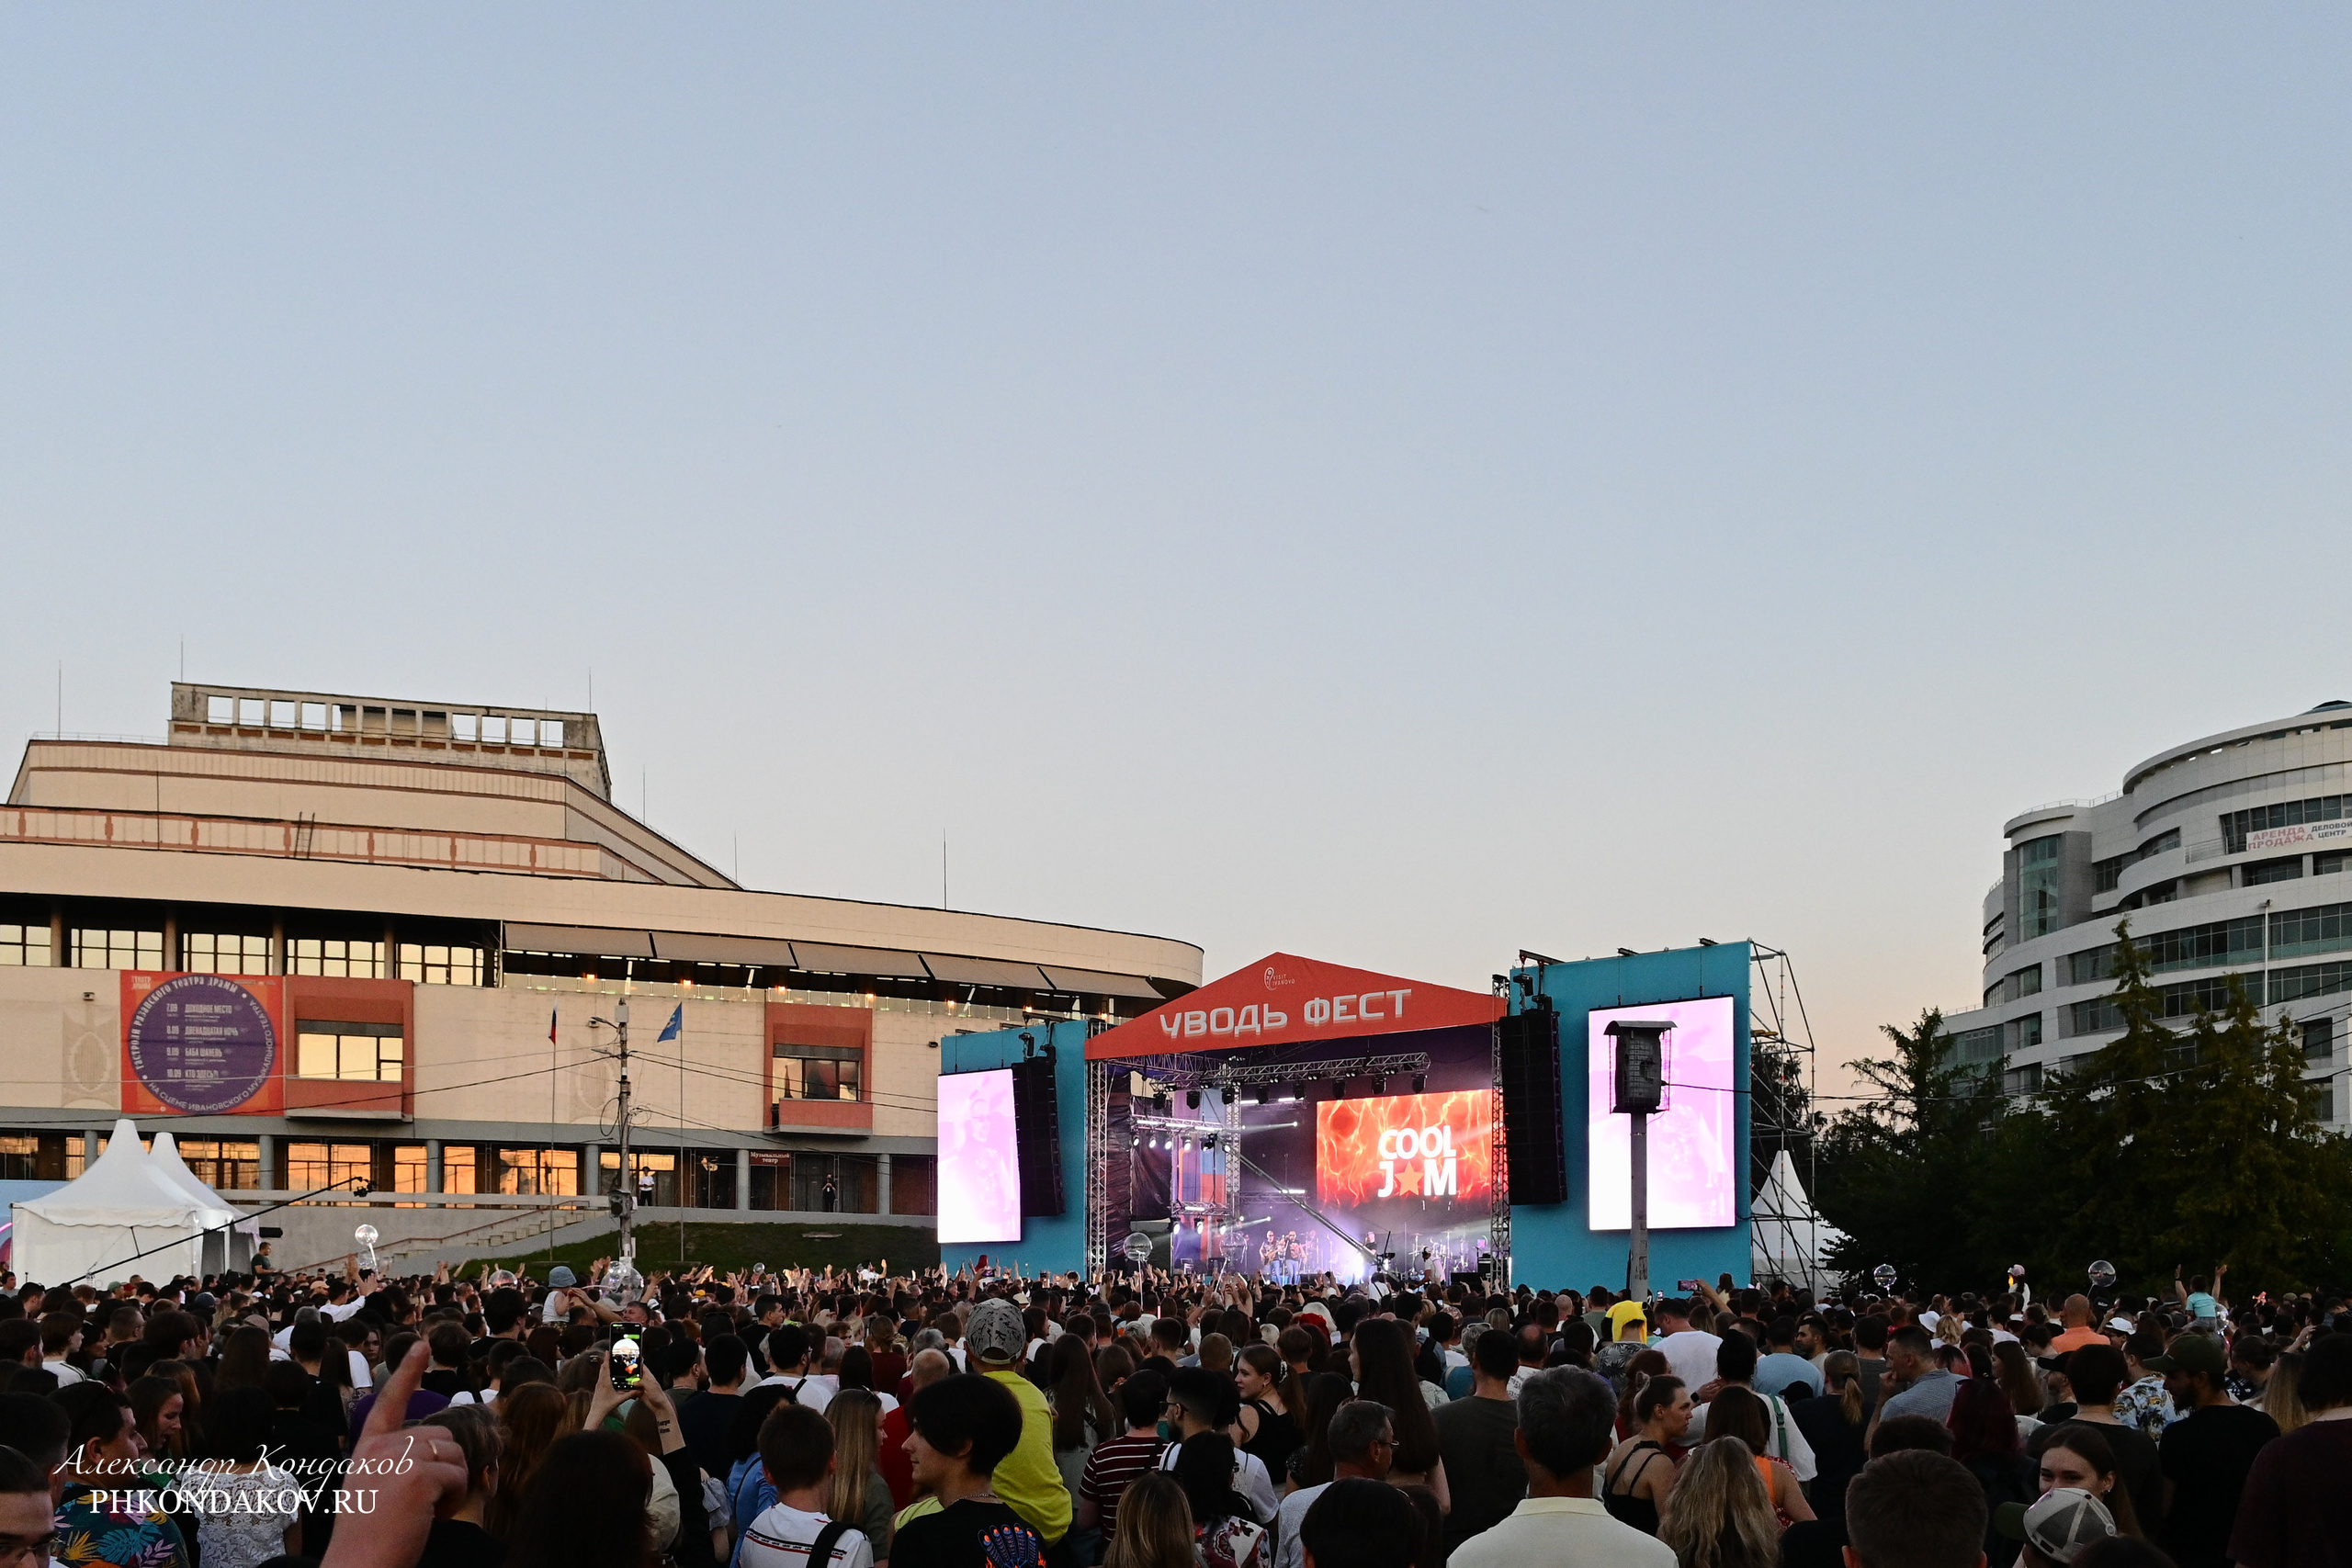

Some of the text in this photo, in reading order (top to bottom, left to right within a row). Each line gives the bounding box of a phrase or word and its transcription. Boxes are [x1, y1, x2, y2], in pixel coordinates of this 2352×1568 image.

[2253, 826, 2305, 841] АРЕНДА
[2312, 821, 2352, 832] ДЕЛОВОЙ
[2318, 829, 2346, 839] ЦЕНТР
[2247, 833, 2314, 850] ПРОДАЖА
[249, 999, 269, 1030] ТЕАТРА
[1159, 988, 1412, 1039] УВОДЬ ФЕСТ
[247, 1030, 274, 1094] МУЗЫКАЛЬНОГО
[148, 1082, 160, 1094] НА
[159, 1091, 187, 1109] СЦЕНЕ
[187, 1090, 249, 1111] ИВАНОВСКОГО
[1378, 1125, 1457, 1160] COOL
[750, 1151, 790, 1159] Музыкальный
